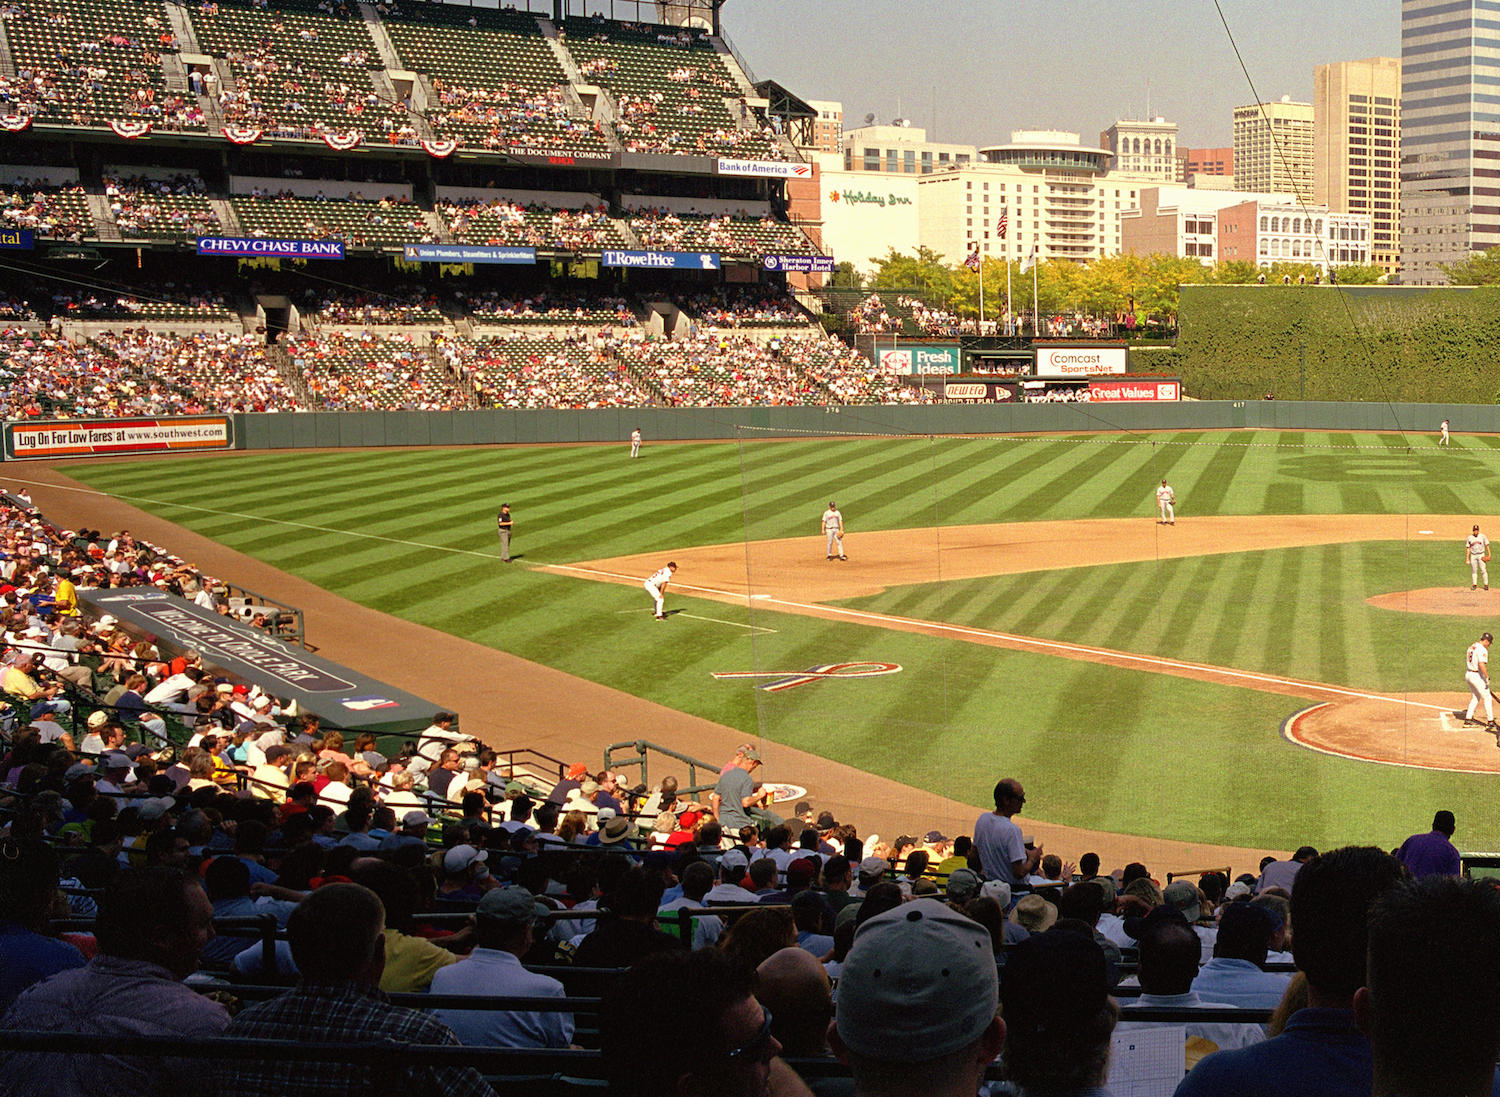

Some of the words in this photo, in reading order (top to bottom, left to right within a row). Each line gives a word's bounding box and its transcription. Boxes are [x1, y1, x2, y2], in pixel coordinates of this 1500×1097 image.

[509, 147, 526, 155] THE
[528, 148, 573, 158] DOCUMENT
[574, 151, 612, 160] COMPANY
[720, 162, 741, 172] Bank
[742, 163, 751, 172] of
[752, 164, 787, 174] America
[842, 189, 885, 207] Holiday
[889, 194, 912, 206] Inn
[200, 239, 251, 251] CHEVY
[252, 241, 298, 253] CHASE
[302, 243, 341, 254] BANK
[779, 256, 812, 264] Sheraton
[782, 263, 809, 271] Harbor
[917, 351, 951, 363] Fresh
[1054, 352, 1100, 364] comcast
[918, 362, 954, 375] Ideas
[1061, 365, 1113, 374] SportsNet
[1092, 388, 1120, 399] Great
[1122, 387, 1154, 398] Values
[19, 433, 36, 448] Log
[38, 433, 50, 445] On
[52, 432, 67, 444] For
[69, 431, 87, 443] Low
[90, 430, 113, 443] Fares
[116, 430, 125, 441] at
[128, 428, 223, 440] www.southwest.com
